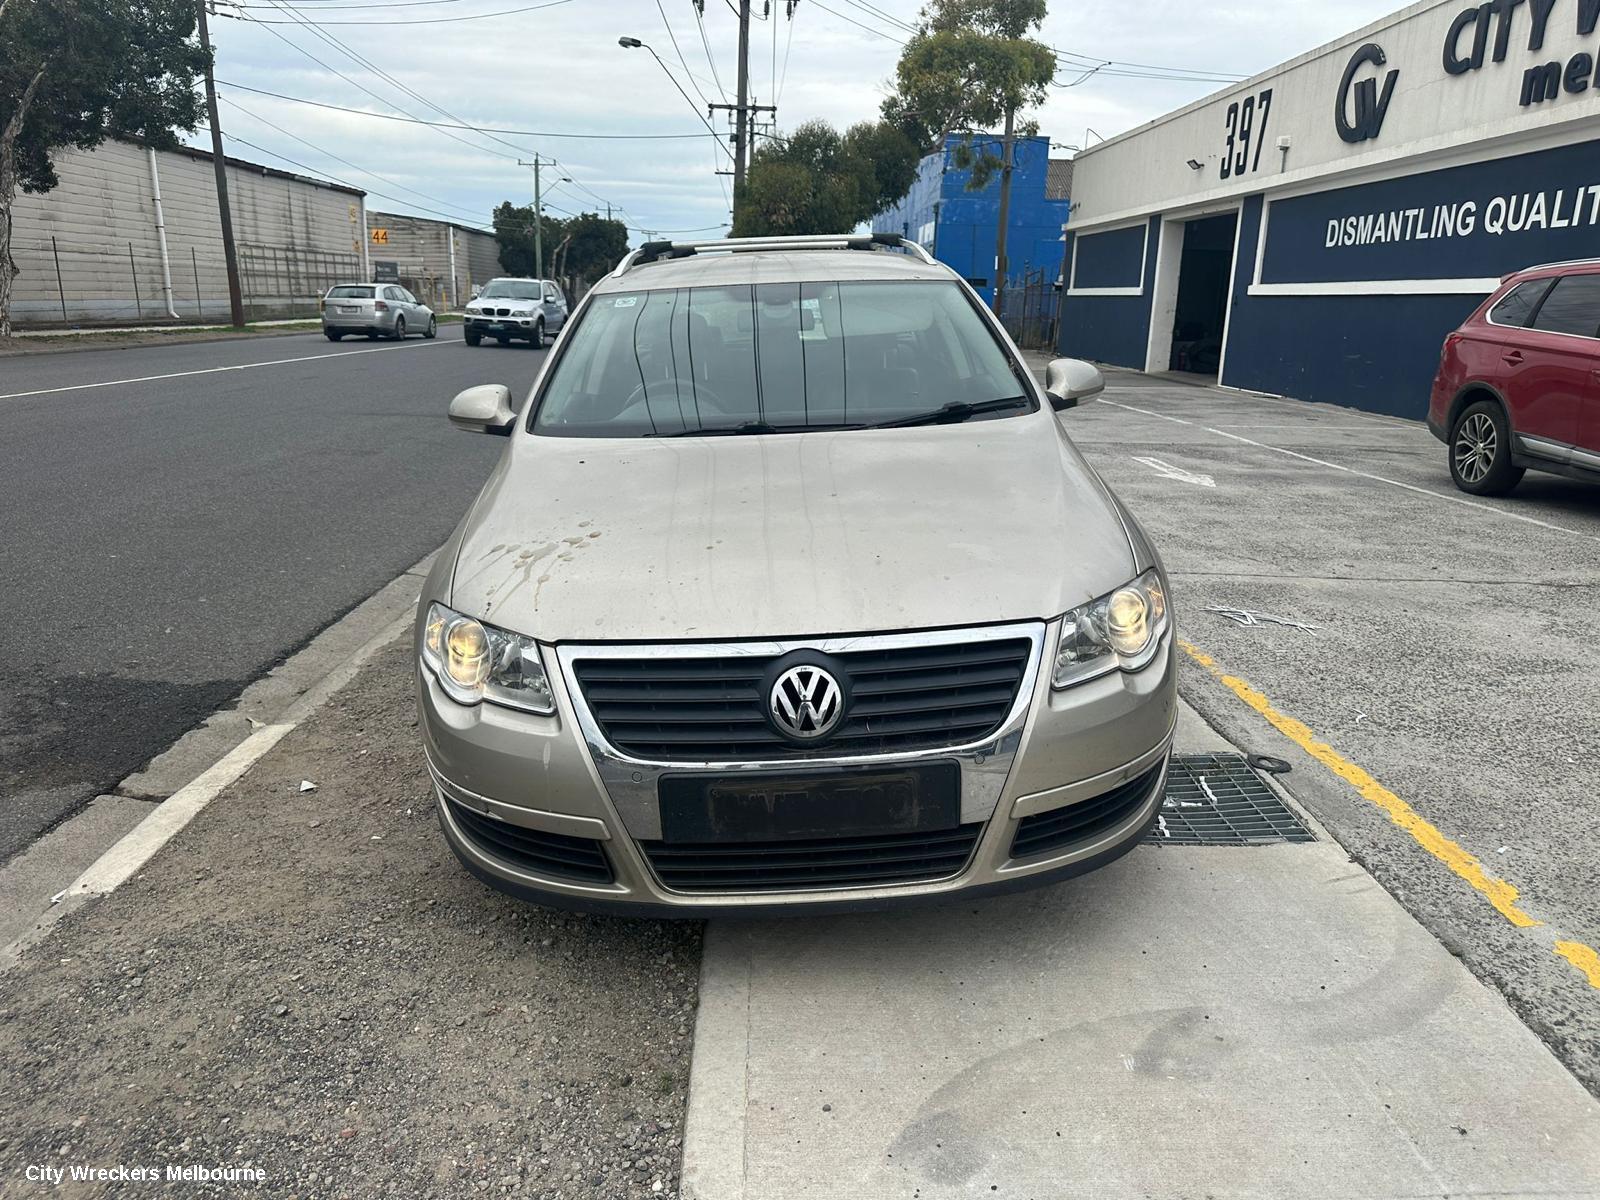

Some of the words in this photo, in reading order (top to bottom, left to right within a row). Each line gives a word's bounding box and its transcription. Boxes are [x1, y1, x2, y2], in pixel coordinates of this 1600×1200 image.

[1443, 0, 1556, 75] CITY
[1220, 89, 1272, 180] 397
[373, 230, 388, 244] 44
[1325, 201, 1477, 247] DISMANTLING
[1484, 184, 1600, 235] QUALIT
